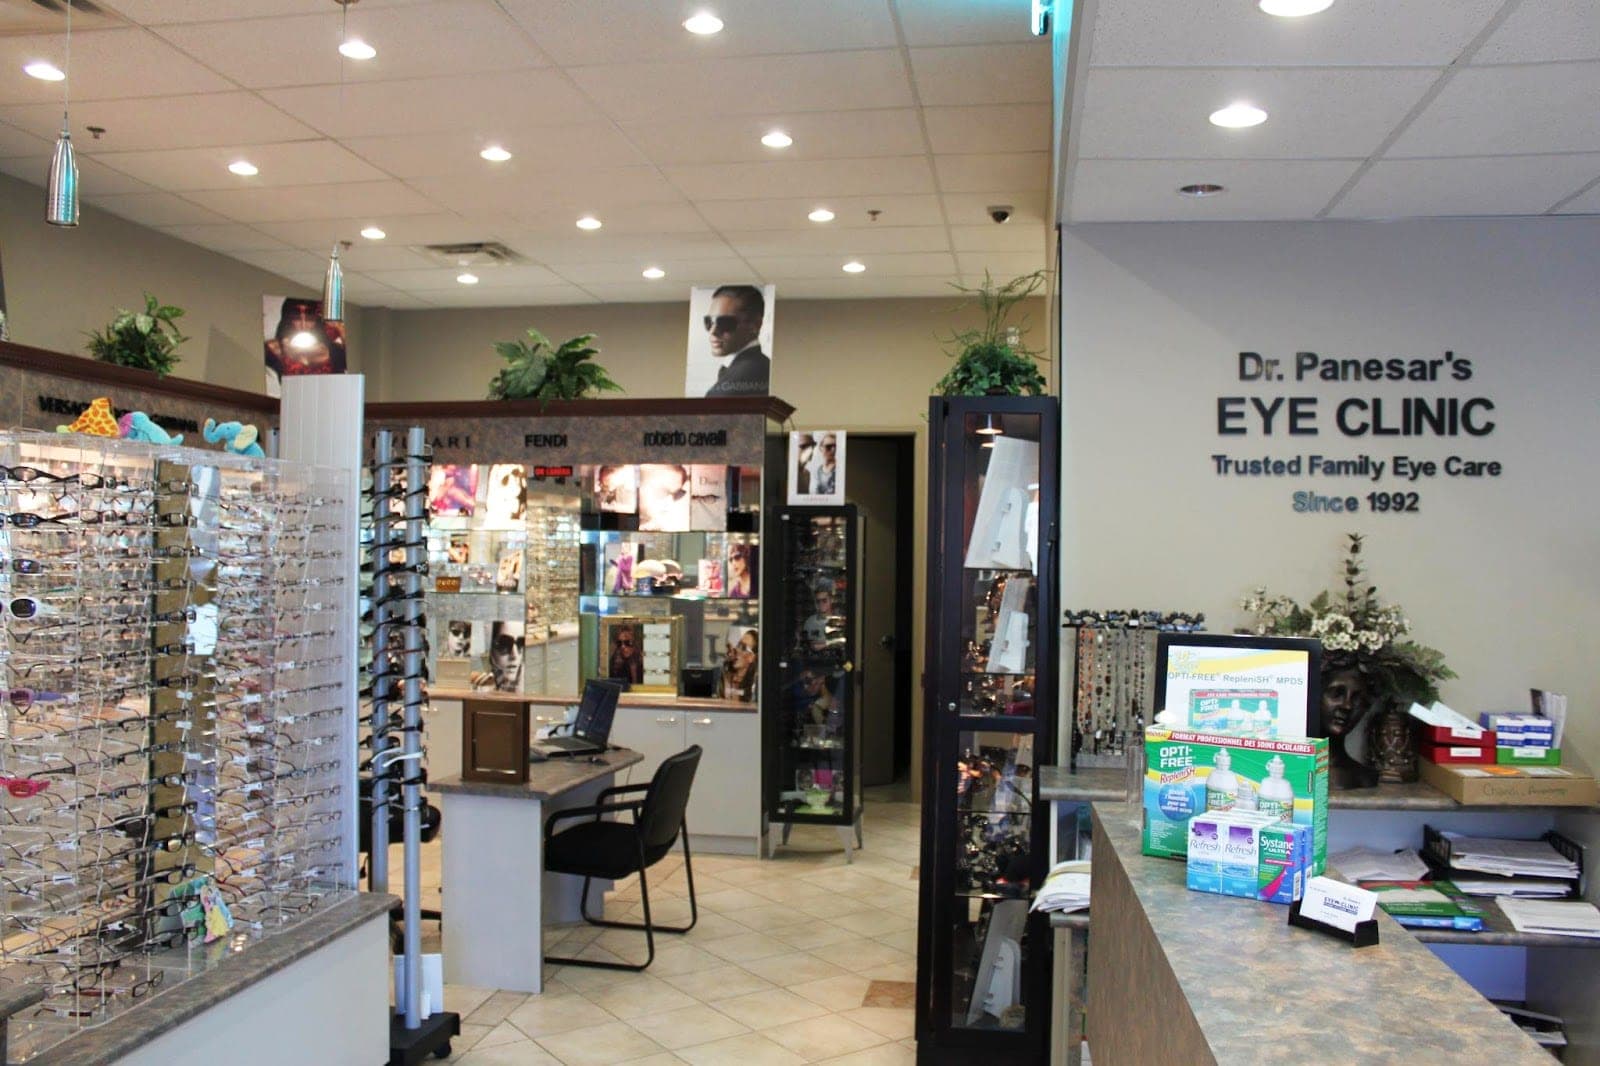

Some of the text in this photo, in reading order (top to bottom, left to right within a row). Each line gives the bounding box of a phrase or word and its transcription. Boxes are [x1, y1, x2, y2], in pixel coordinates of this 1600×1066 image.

[1238, 351, 1473, 381] Dr. Panesar's
[1217, 397, 1496, 436] EYE CLINIC
[525, 434, 568, 448] FENDI
[1212, 455, 1503, 481] Trusted Family Eye Care
[1293, 491, 1420, 512] Since 1992
[1171, 731, 1197, 742] FORMAT
[1196, 734, 1242, 747] PROFESSIONNEL
[1244, 739, 1256, 748] DES
[1257, 741, 1275, 750] SOINS
[1276, 742, 1311, 753] OCULAIRES
[1159, 745, 1193, 758] OPTI-
[1160, 755, 1193, 768] FREE
[1190, 840, 1220, 852] Refresh
[1225, 842, 1257, 857] Refresh
